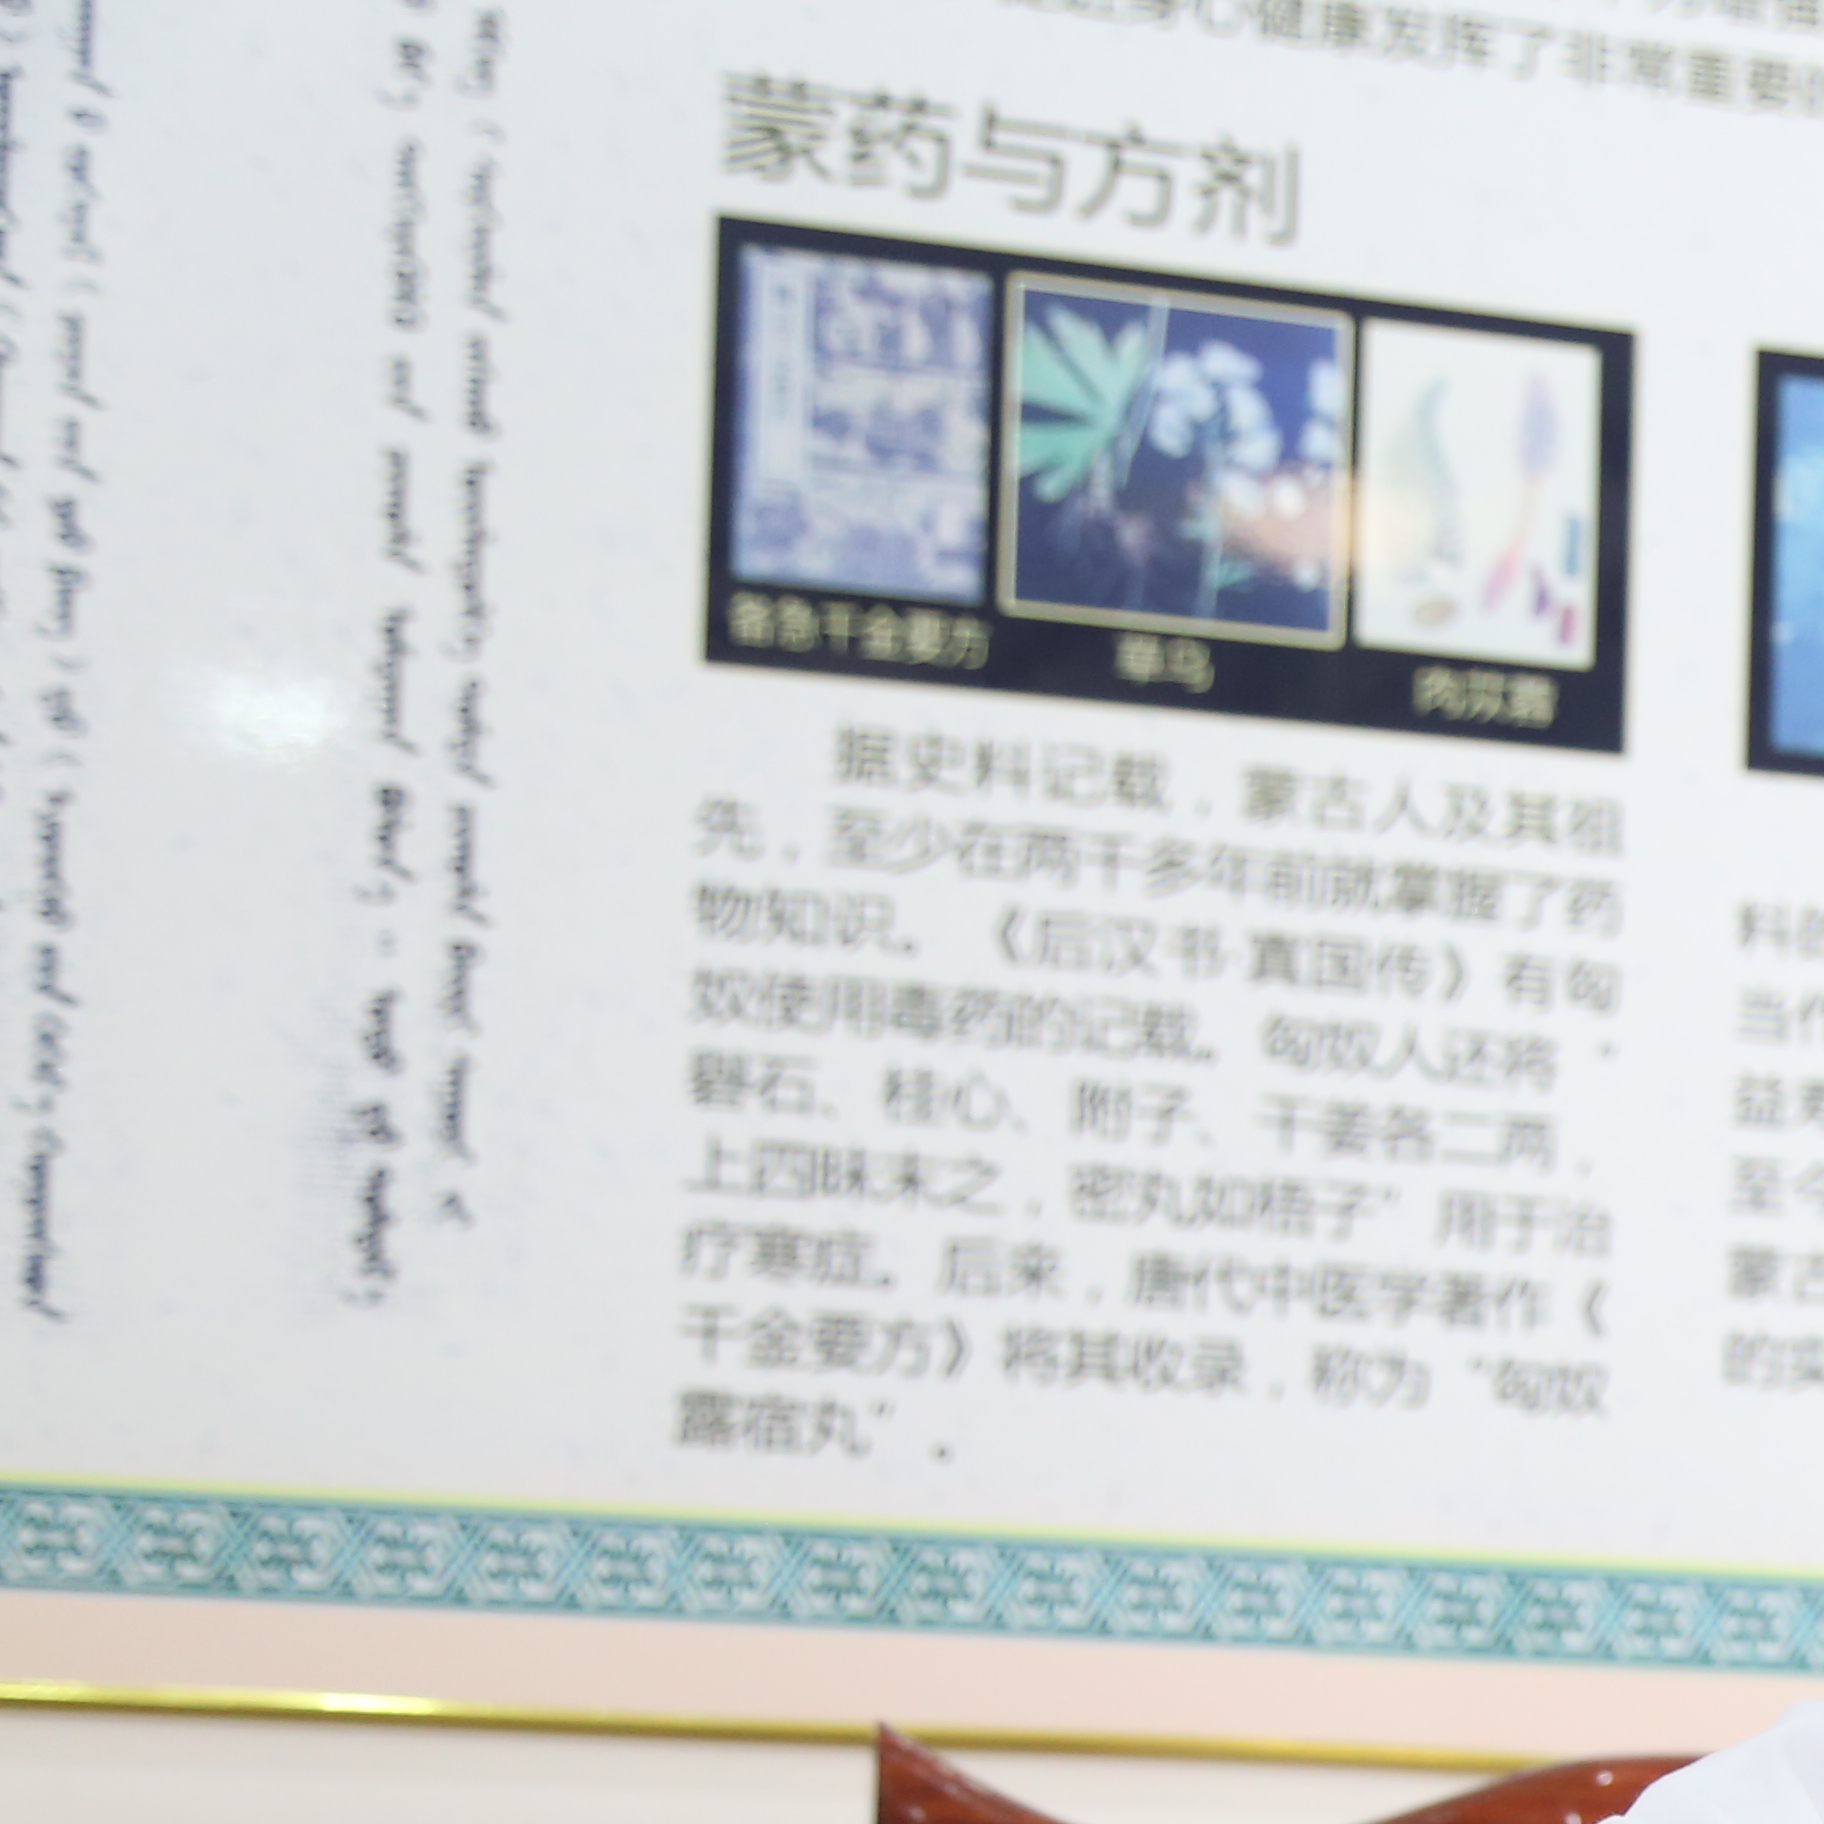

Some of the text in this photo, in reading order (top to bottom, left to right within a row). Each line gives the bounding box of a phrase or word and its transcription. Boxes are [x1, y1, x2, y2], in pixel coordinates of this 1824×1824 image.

[722, 70, 1304, 246] 蒙药与方剂
